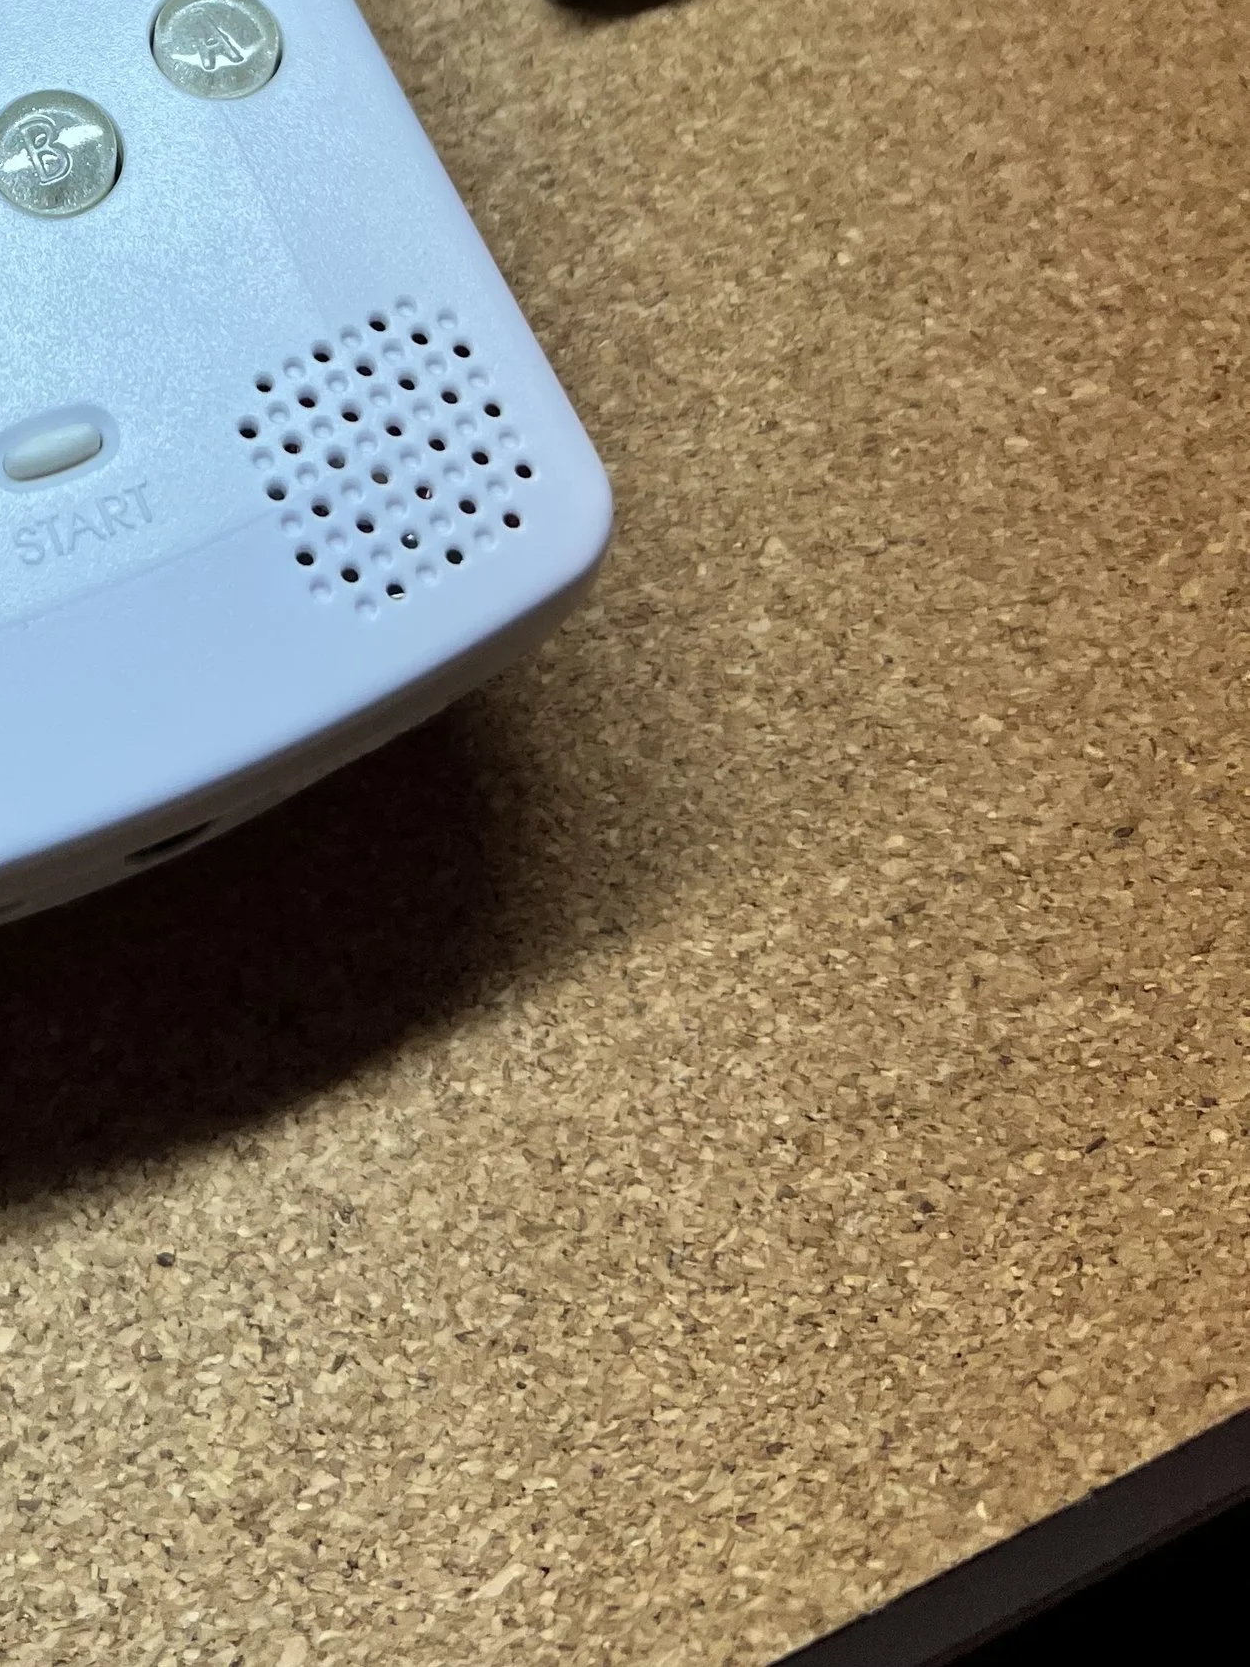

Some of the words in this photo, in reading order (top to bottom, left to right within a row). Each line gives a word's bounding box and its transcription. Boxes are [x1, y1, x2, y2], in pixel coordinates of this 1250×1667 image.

[199, 10, 245, 72] A
[18, 114, 73, 185] B
[12, 481, 154, 566] START
